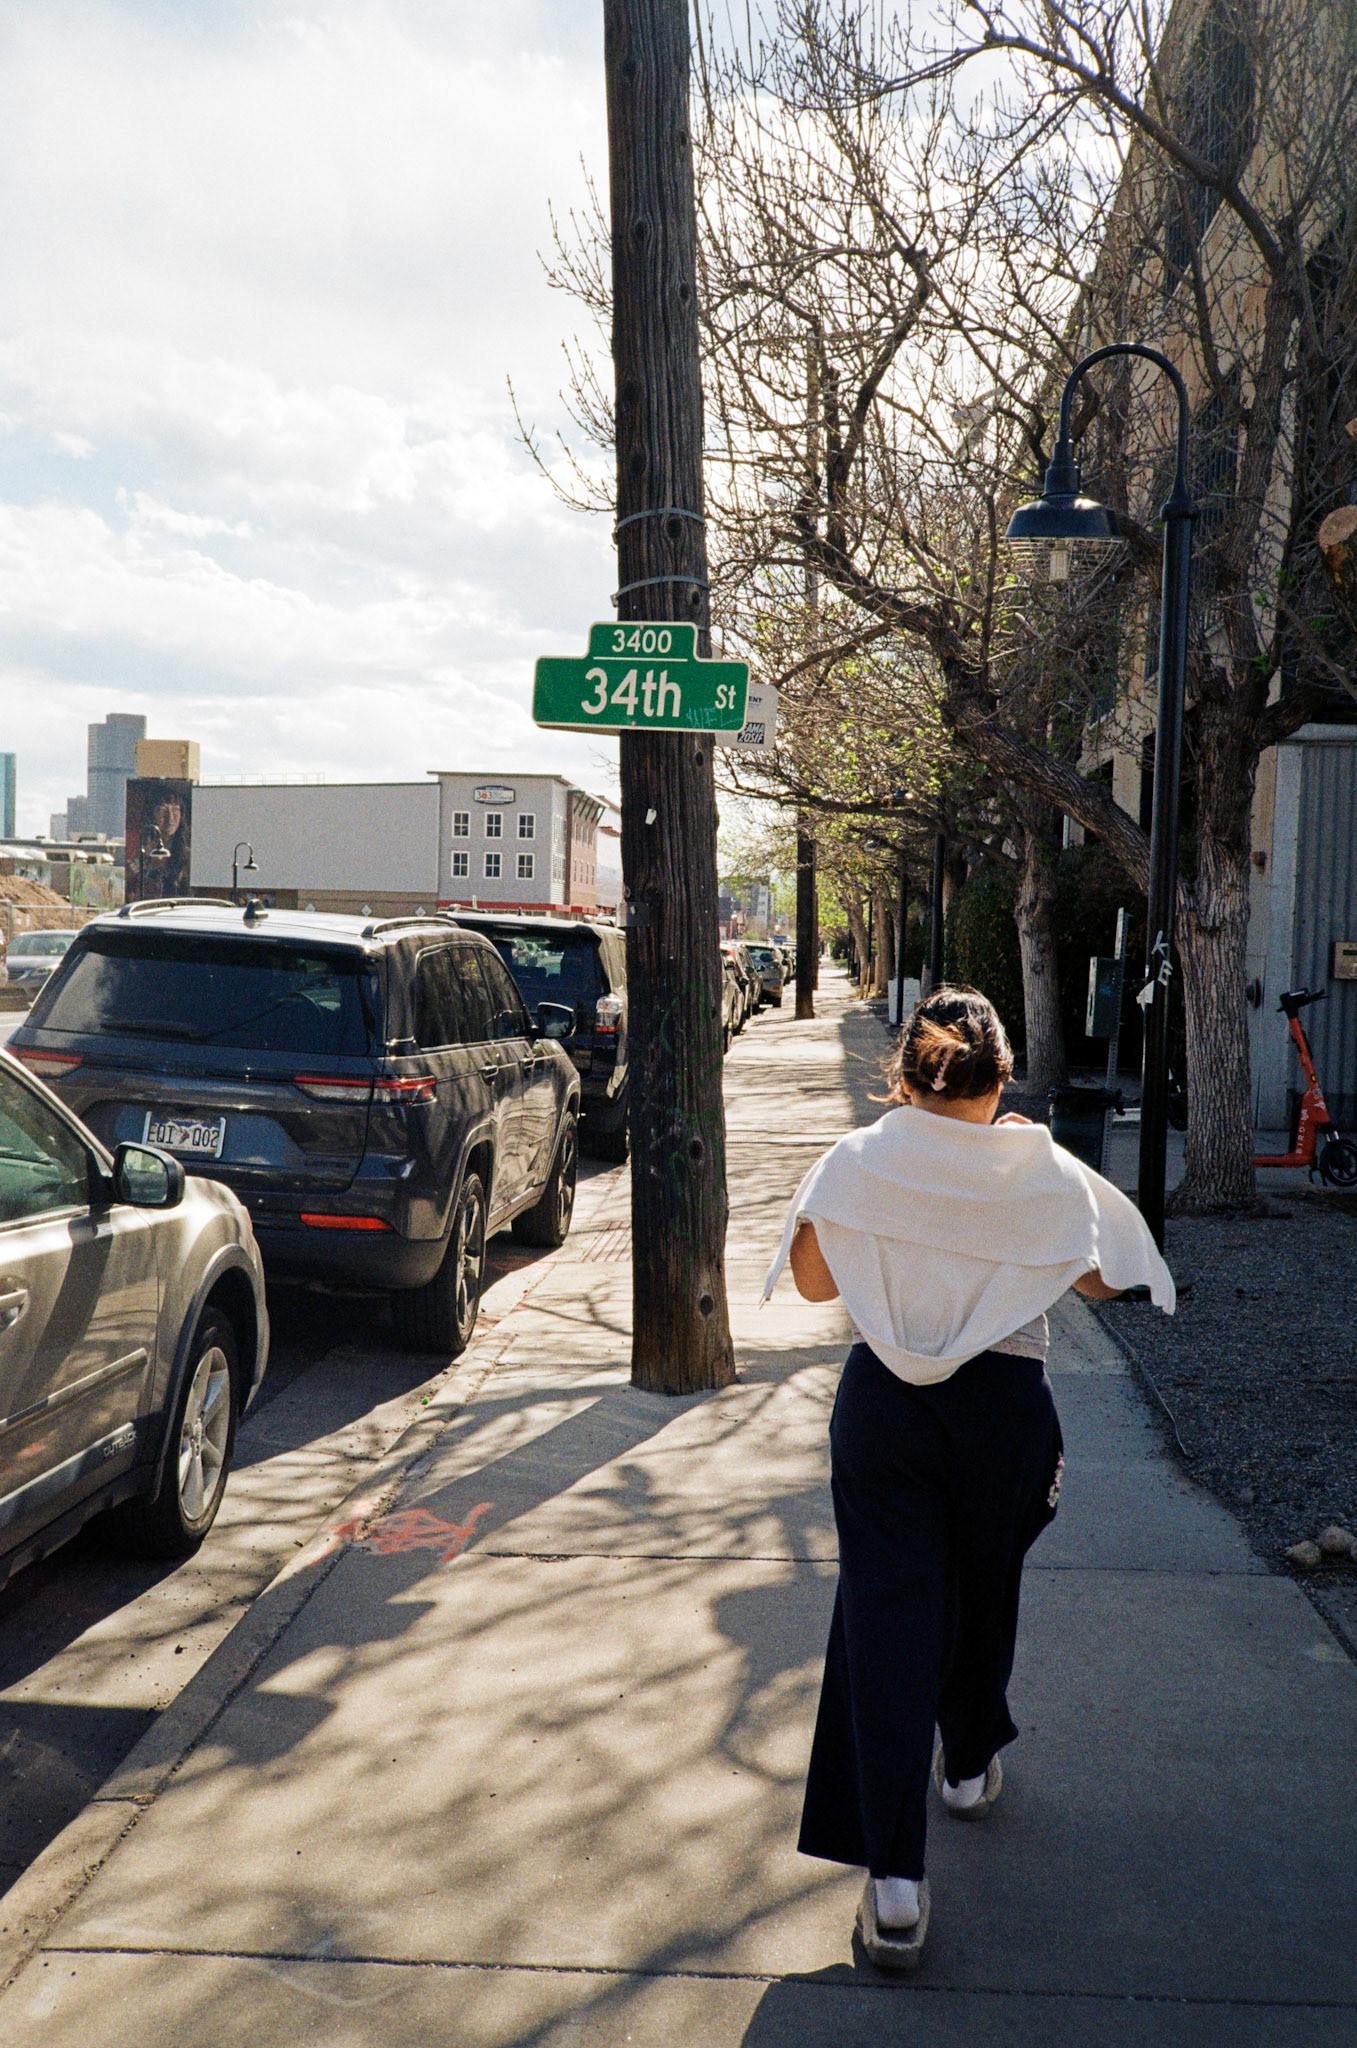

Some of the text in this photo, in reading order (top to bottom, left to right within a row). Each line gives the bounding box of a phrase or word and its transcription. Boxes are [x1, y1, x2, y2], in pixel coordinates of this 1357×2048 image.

[611, 629, 672, 654] 3400
[581, 667, 682, 718] 34th
[714, 684, 737, 710] St
[192, 1127, 220, 1148] Q02
[1295, 1126, 1306, 1154] BIRD
